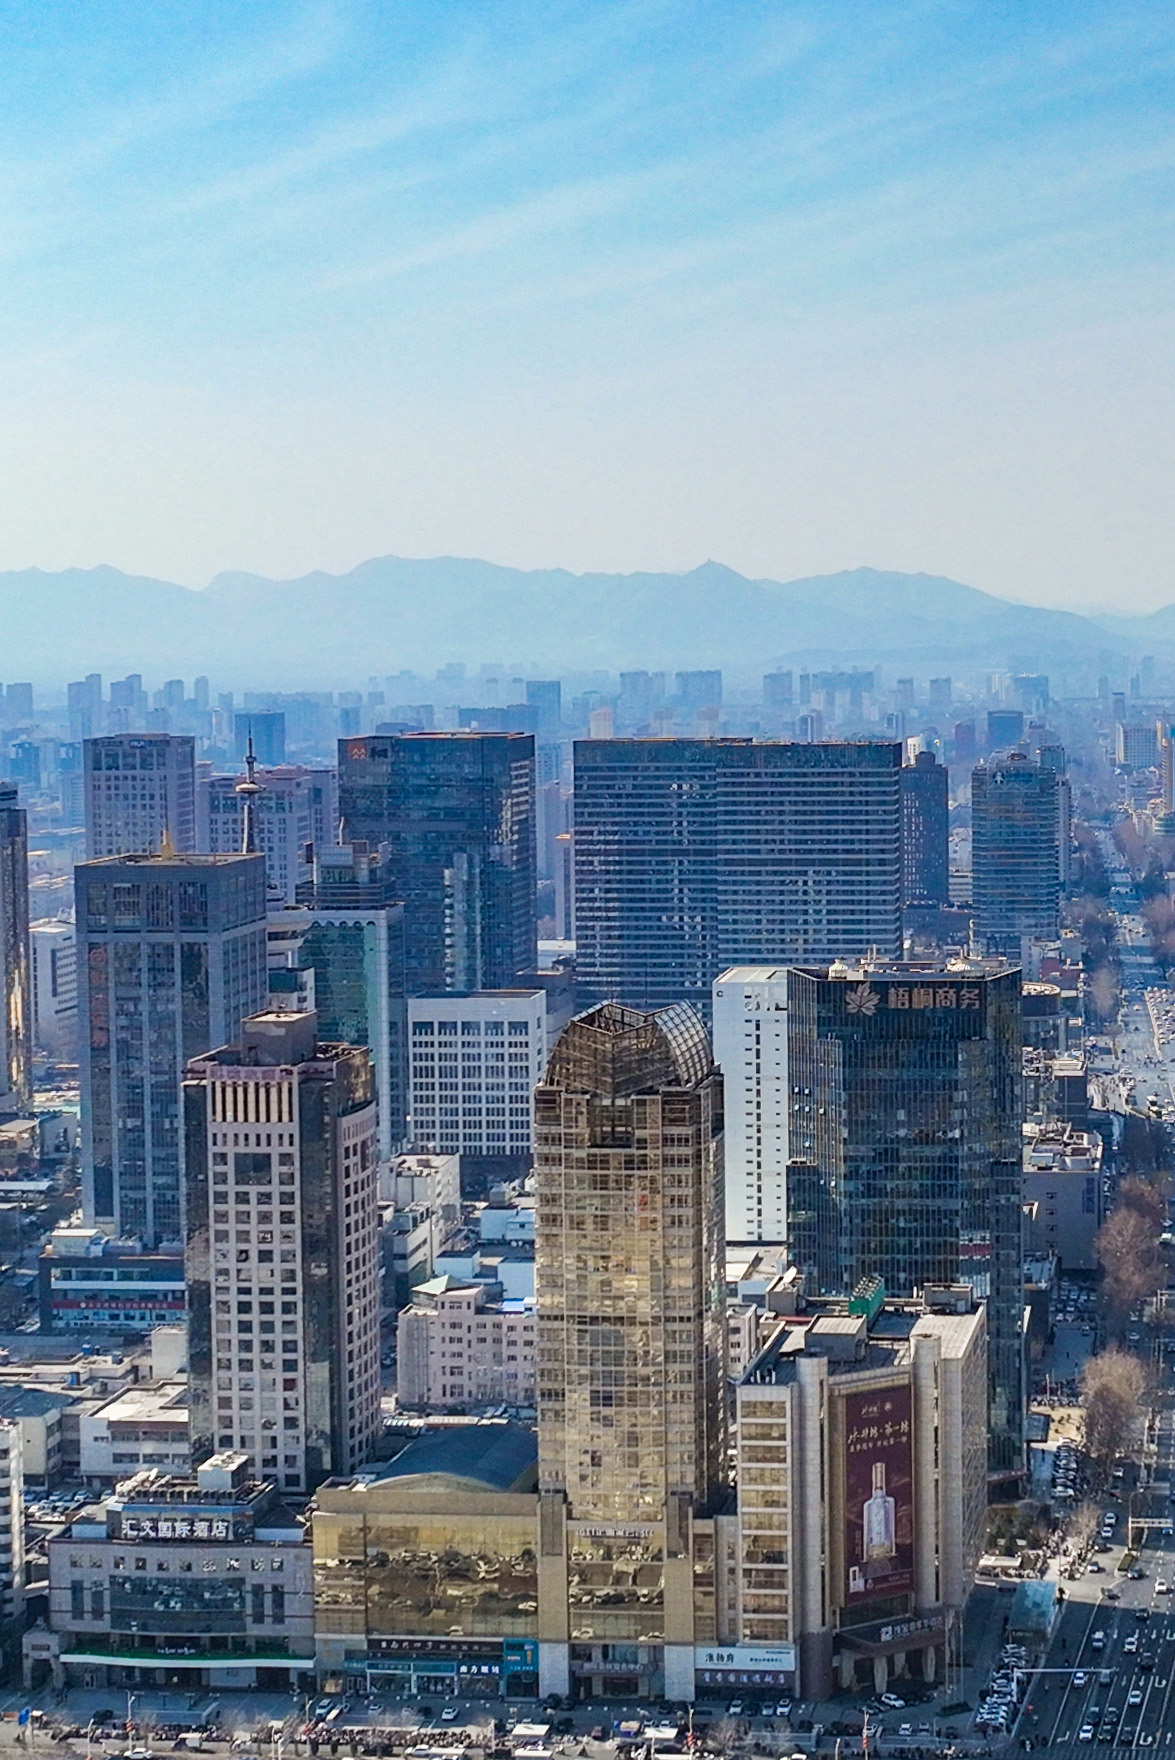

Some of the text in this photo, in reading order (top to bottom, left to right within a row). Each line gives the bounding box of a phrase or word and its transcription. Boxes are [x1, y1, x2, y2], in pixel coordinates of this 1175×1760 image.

[888, 987, 980, 1009] 梧桐商务
[121, 1519, 228, 1538] 汇文国际酒店
